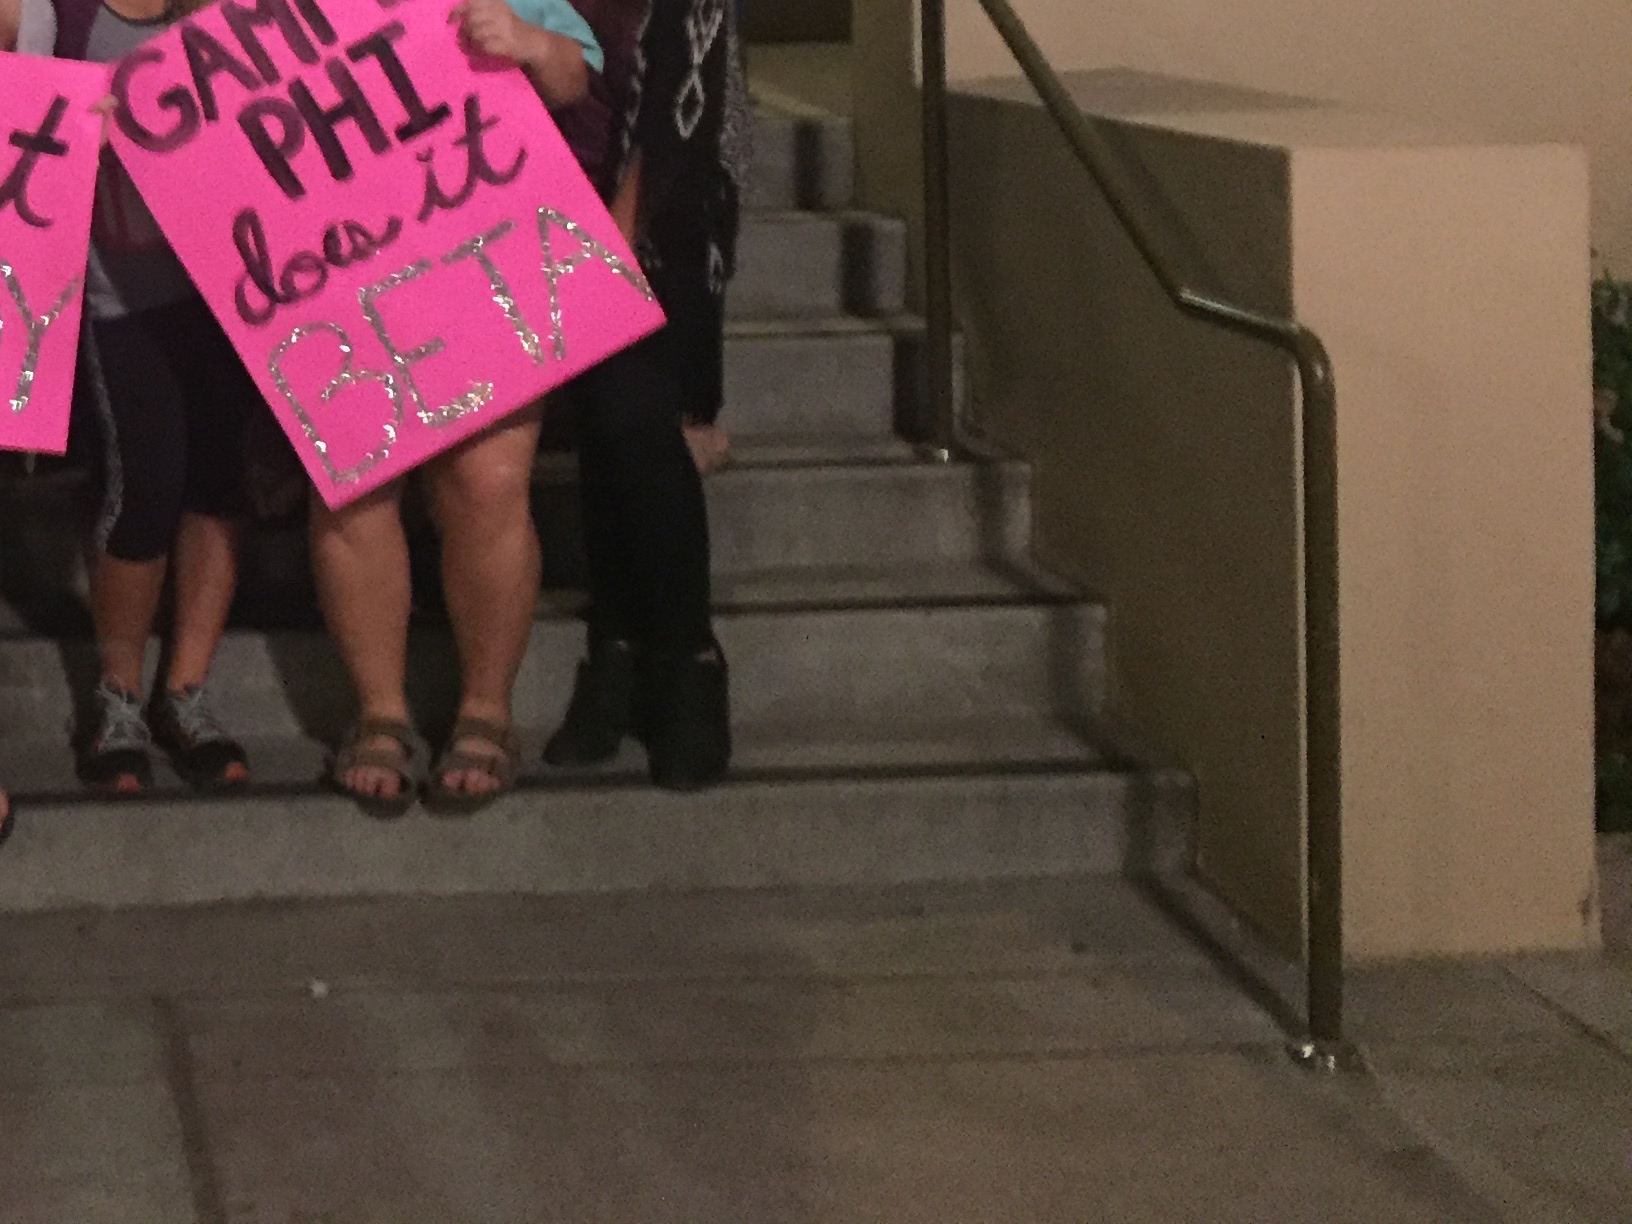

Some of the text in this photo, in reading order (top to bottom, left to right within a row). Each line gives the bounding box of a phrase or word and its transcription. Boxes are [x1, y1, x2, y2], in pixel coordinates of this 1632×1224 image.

[232, 93, 528, 325] does it
[237, 22, 452, 199] PHI
[268, 206, 653, 484] BETA
